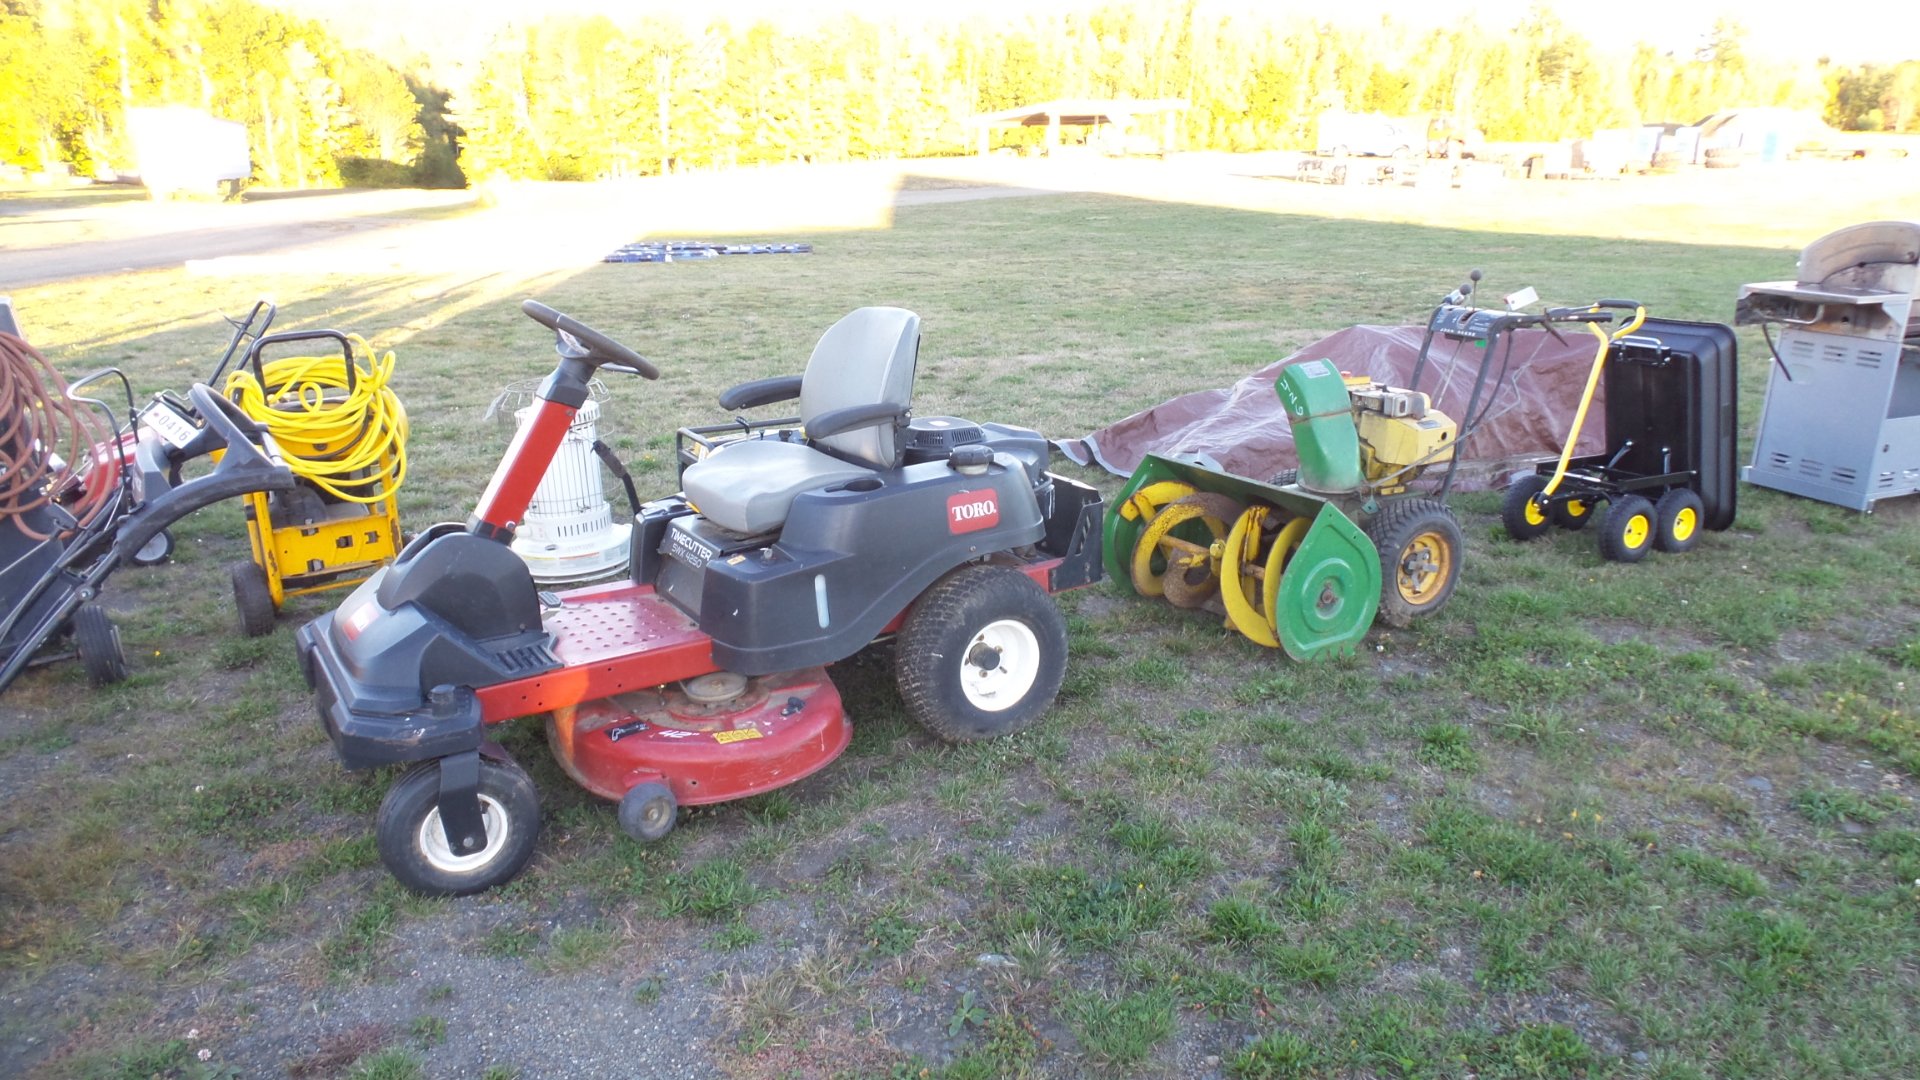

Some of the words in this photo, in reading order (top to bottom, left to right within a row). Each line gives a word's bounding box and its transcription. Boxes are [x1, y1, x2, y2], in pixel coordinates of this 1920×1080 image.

[158, 415, 191, 441] 0416
[951, 499, 995, 522] TORO
[671, 527, 713, 561] TIMECUTTER
